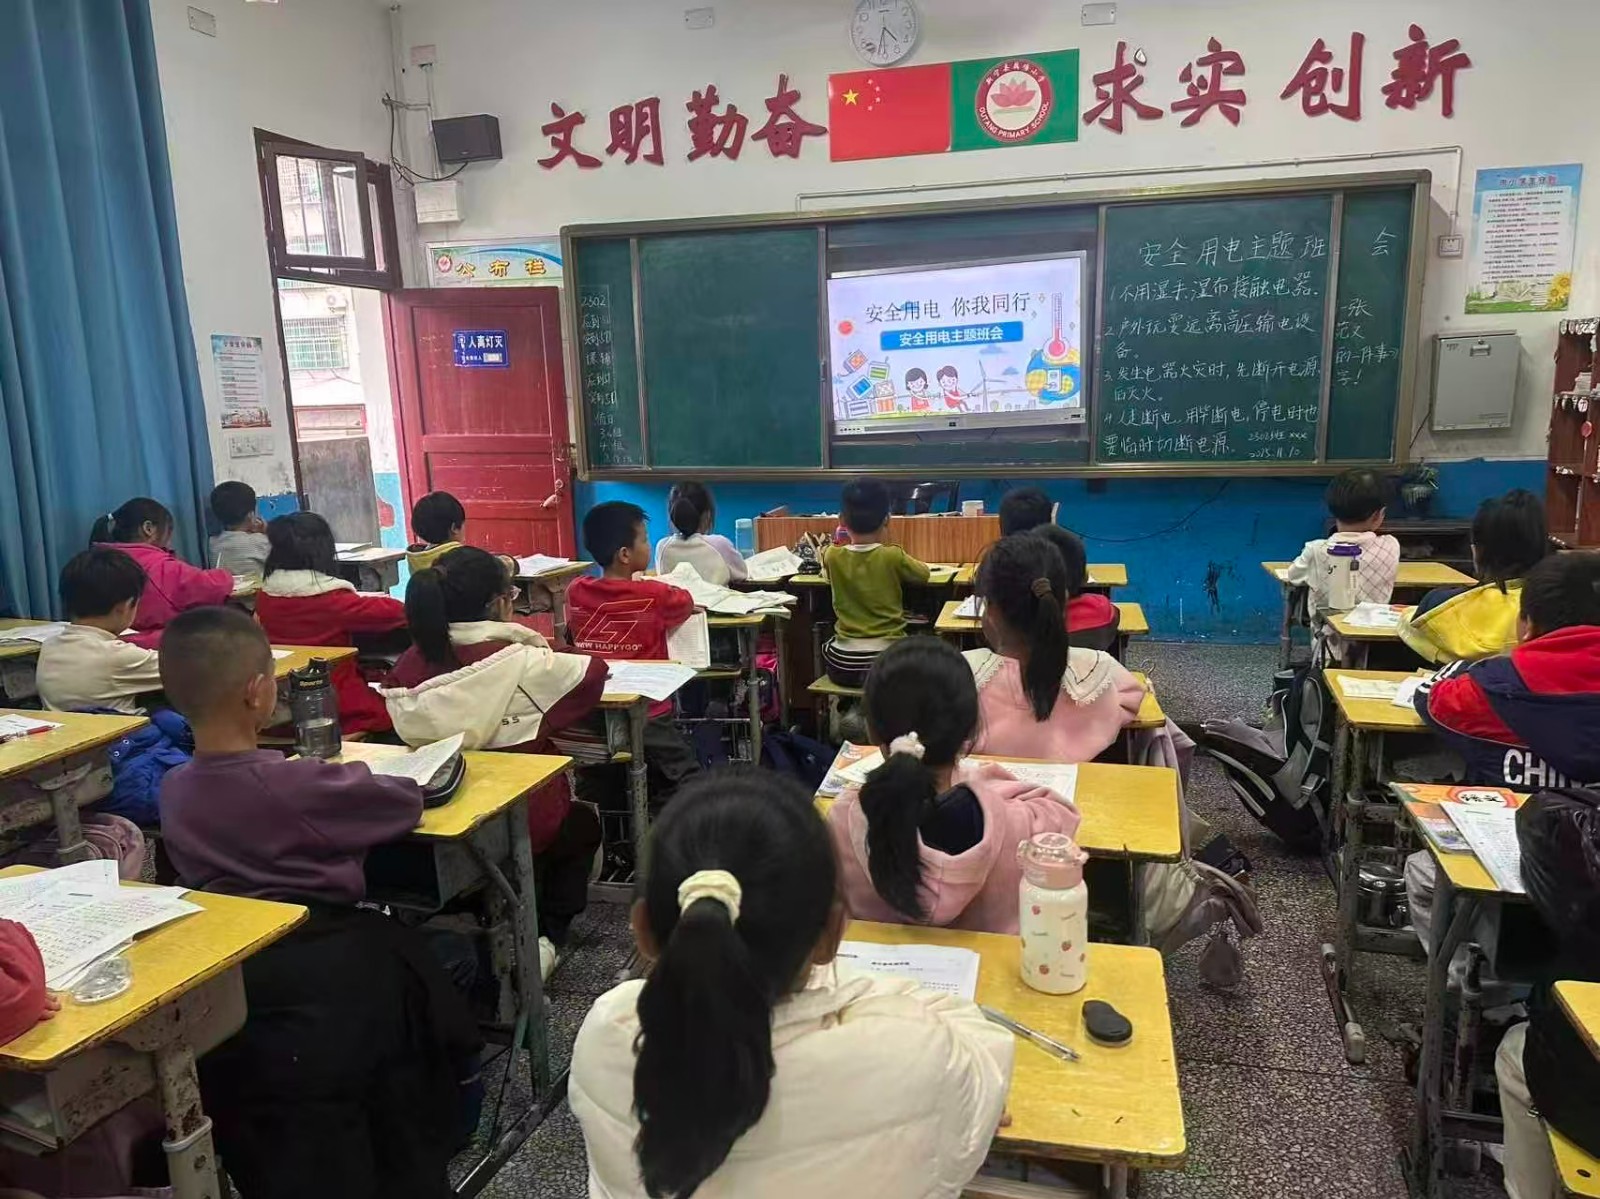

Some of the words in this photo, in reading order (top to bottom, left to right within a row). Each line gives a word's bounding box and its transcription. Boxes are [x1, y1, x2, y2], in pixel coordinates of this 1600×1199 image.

[1082, 36, 1247, 135] 求实
[1279, 23, 1471, 122] 创新
[537, 96, 664, 169] 文明
[686, 74, 827, 163] 勤奋
[998, 126, 1030, 139] PRIMARY
[1030, 102, 1050, 129] SCHOOL
[1371, 226, 1397, 257] 会
[456, 258, 547, 278] 公布栏
[866, 298, 941, 324] 安全用电
[951, 291, 1031, 317] 你我同行
[899, 325, 1004, 348] 安全用电主题班会
